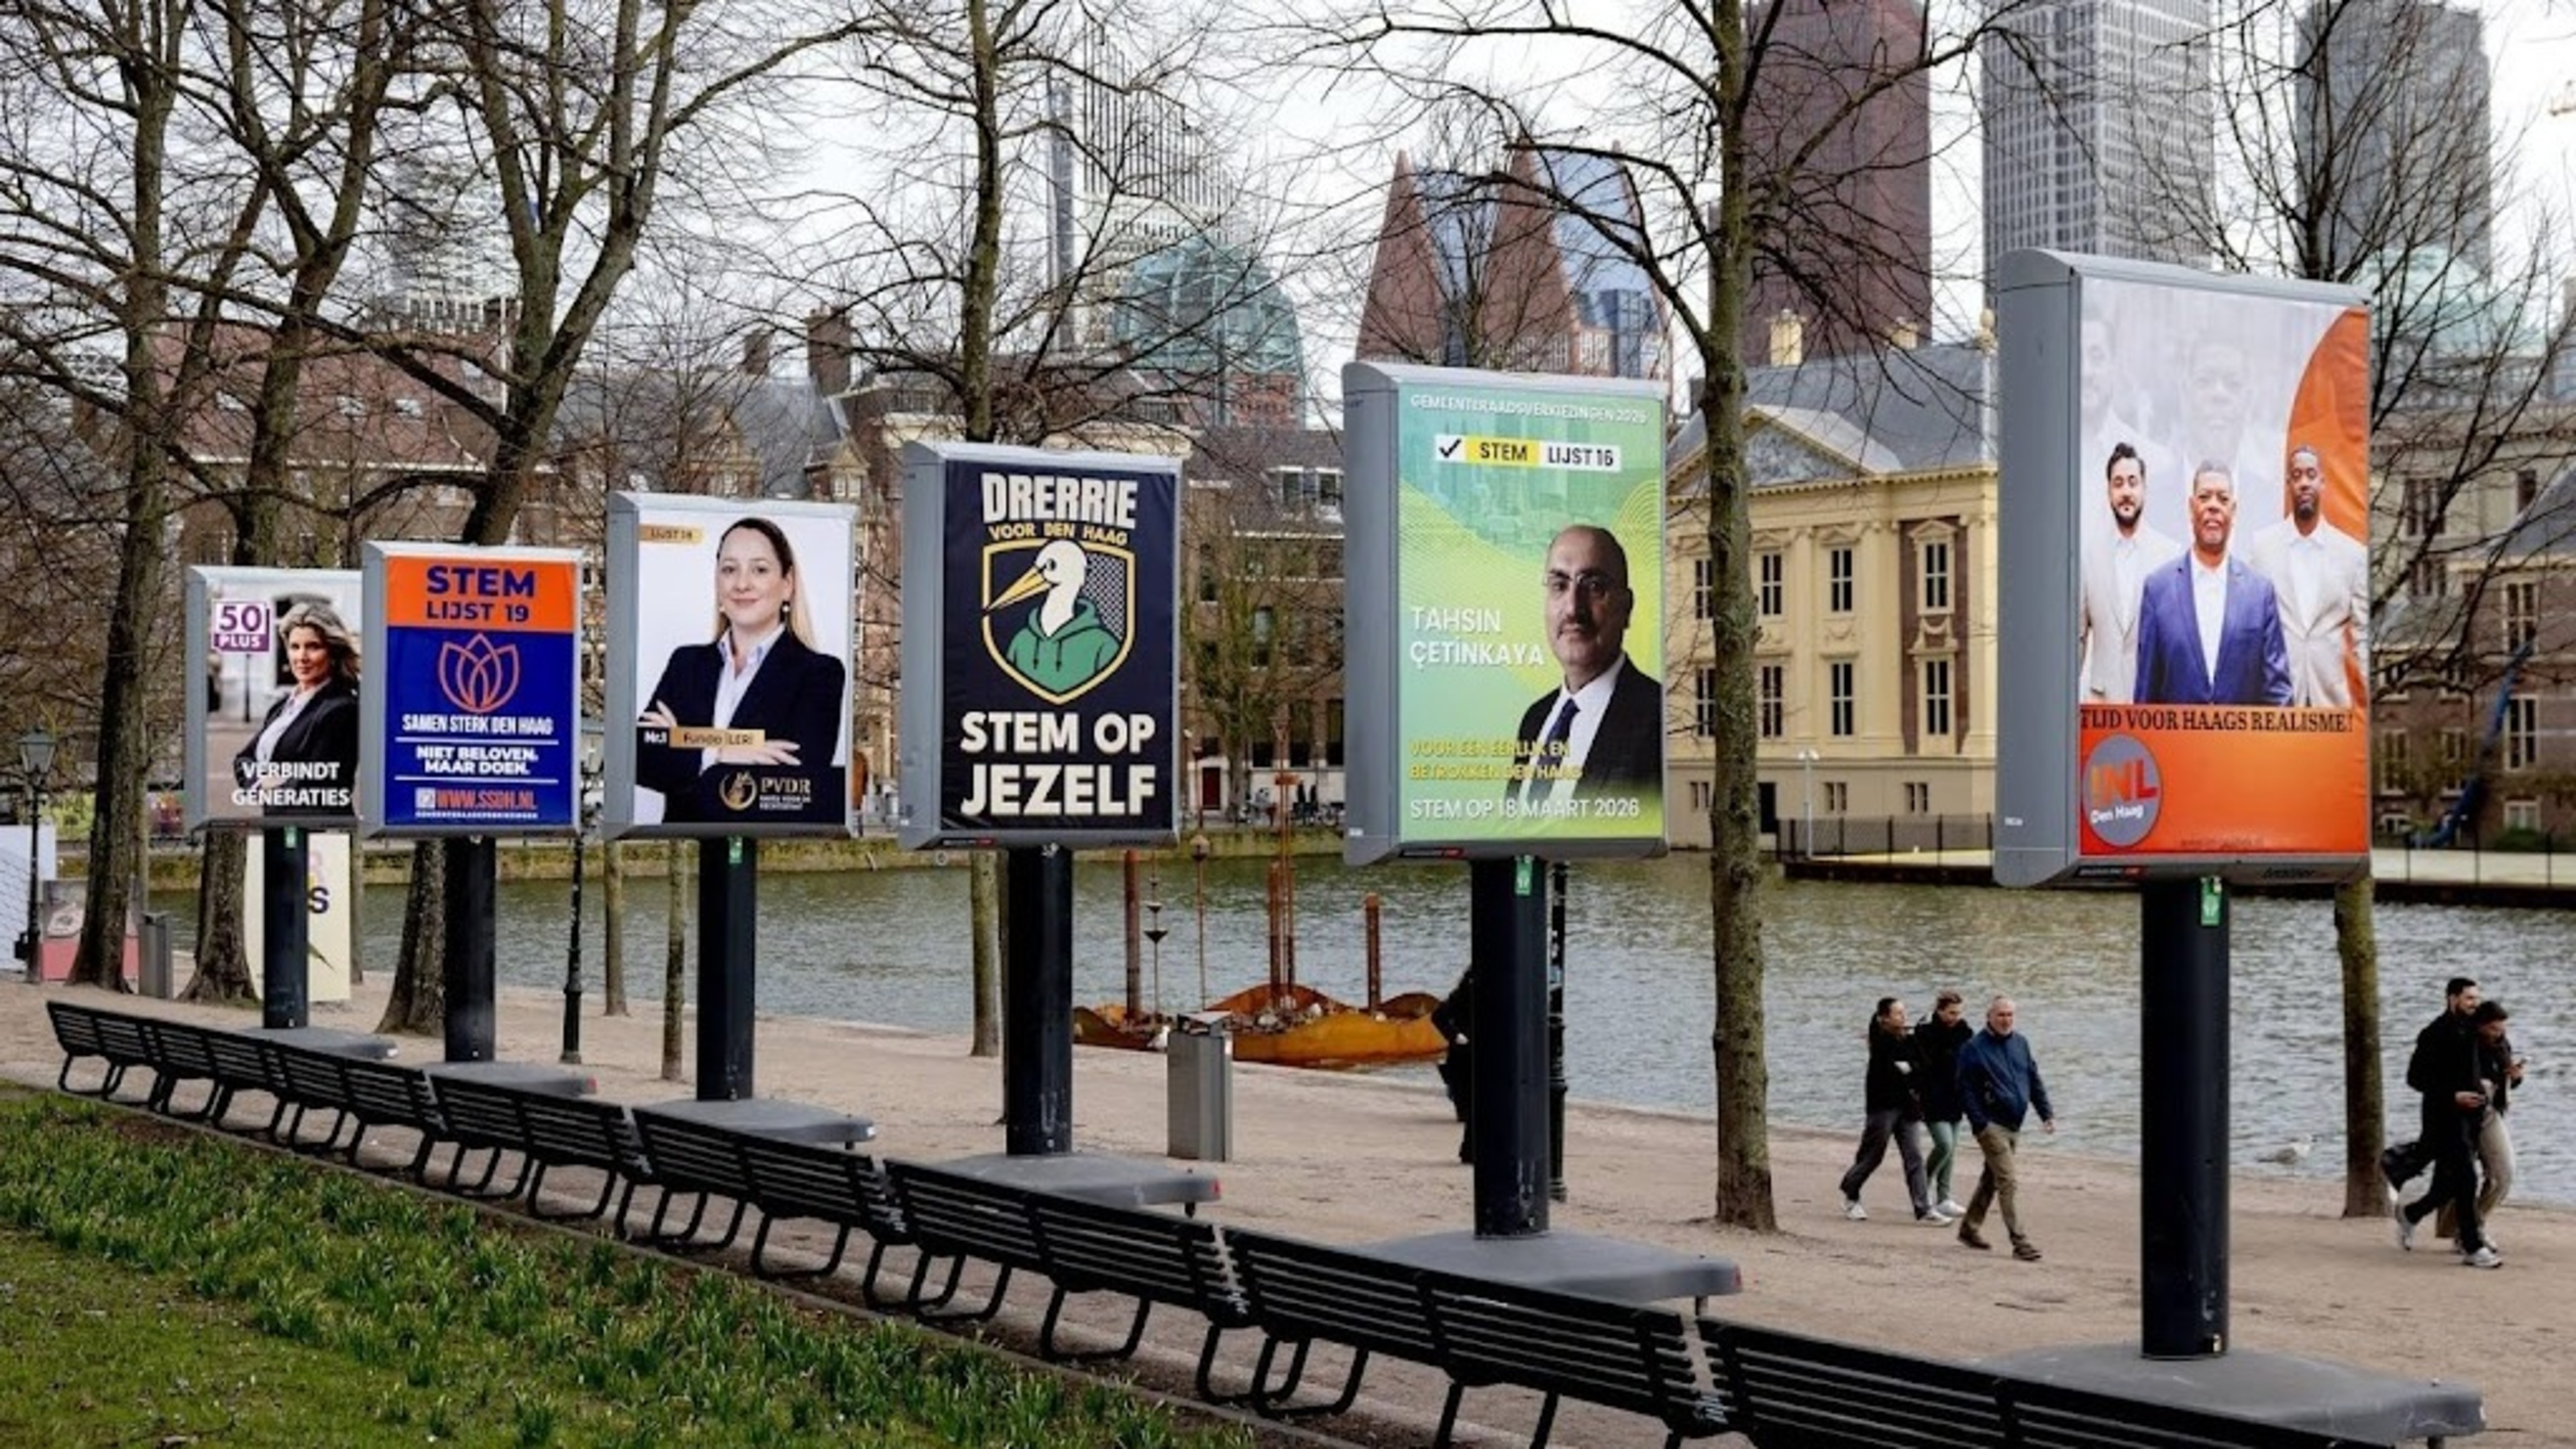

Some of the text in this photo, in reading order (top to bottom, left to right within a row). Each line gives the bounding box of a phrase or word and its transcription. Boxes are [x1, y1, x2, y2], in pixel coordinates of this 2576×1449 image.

[1479, 442, 1614, 466] STEM LIJST 16
[981, 472, 1137, 529] DRERRIE
[988, 522, 1128, 545] VOOR DEN HAAG
[427, 565, 535, 598] STEM
[219, 605, 262, 633] 50
[427, 601, 529, 623] LIJST 19
[1412, 607, 1501, 633] TAHSIN
[219, 636, 260, 649] PLUS
[1410, 636, 1544, 669] ÇETİNKAYA
[402, 714, 553, 735] SAMEN STERK DEN HAAG
[960, 711, 1155, 753] STEM OP
[2126, 709, 2179, 731] VOOR
[2182, 710, 2247, 731] HAAGS
[2251, 711, 2353, 733] REALISME!
[416, 745, 539, 761] NIET BELOVEN.
[1550, 741, 1570, 756] EN
[242, 762, 339, 780] VERBINDT
[425, 760, 531, 775] MAAR DOEN.
[761, 777, 810, 794] PVDR
[960, 763, 1155, 816] JEZELF
[231, 789, 350, 805] GENERATIES
[1411, 798, 1640, 818] STEM OP 18 MAART 2026
[2091, 805, 2144, 824] Den Haag
